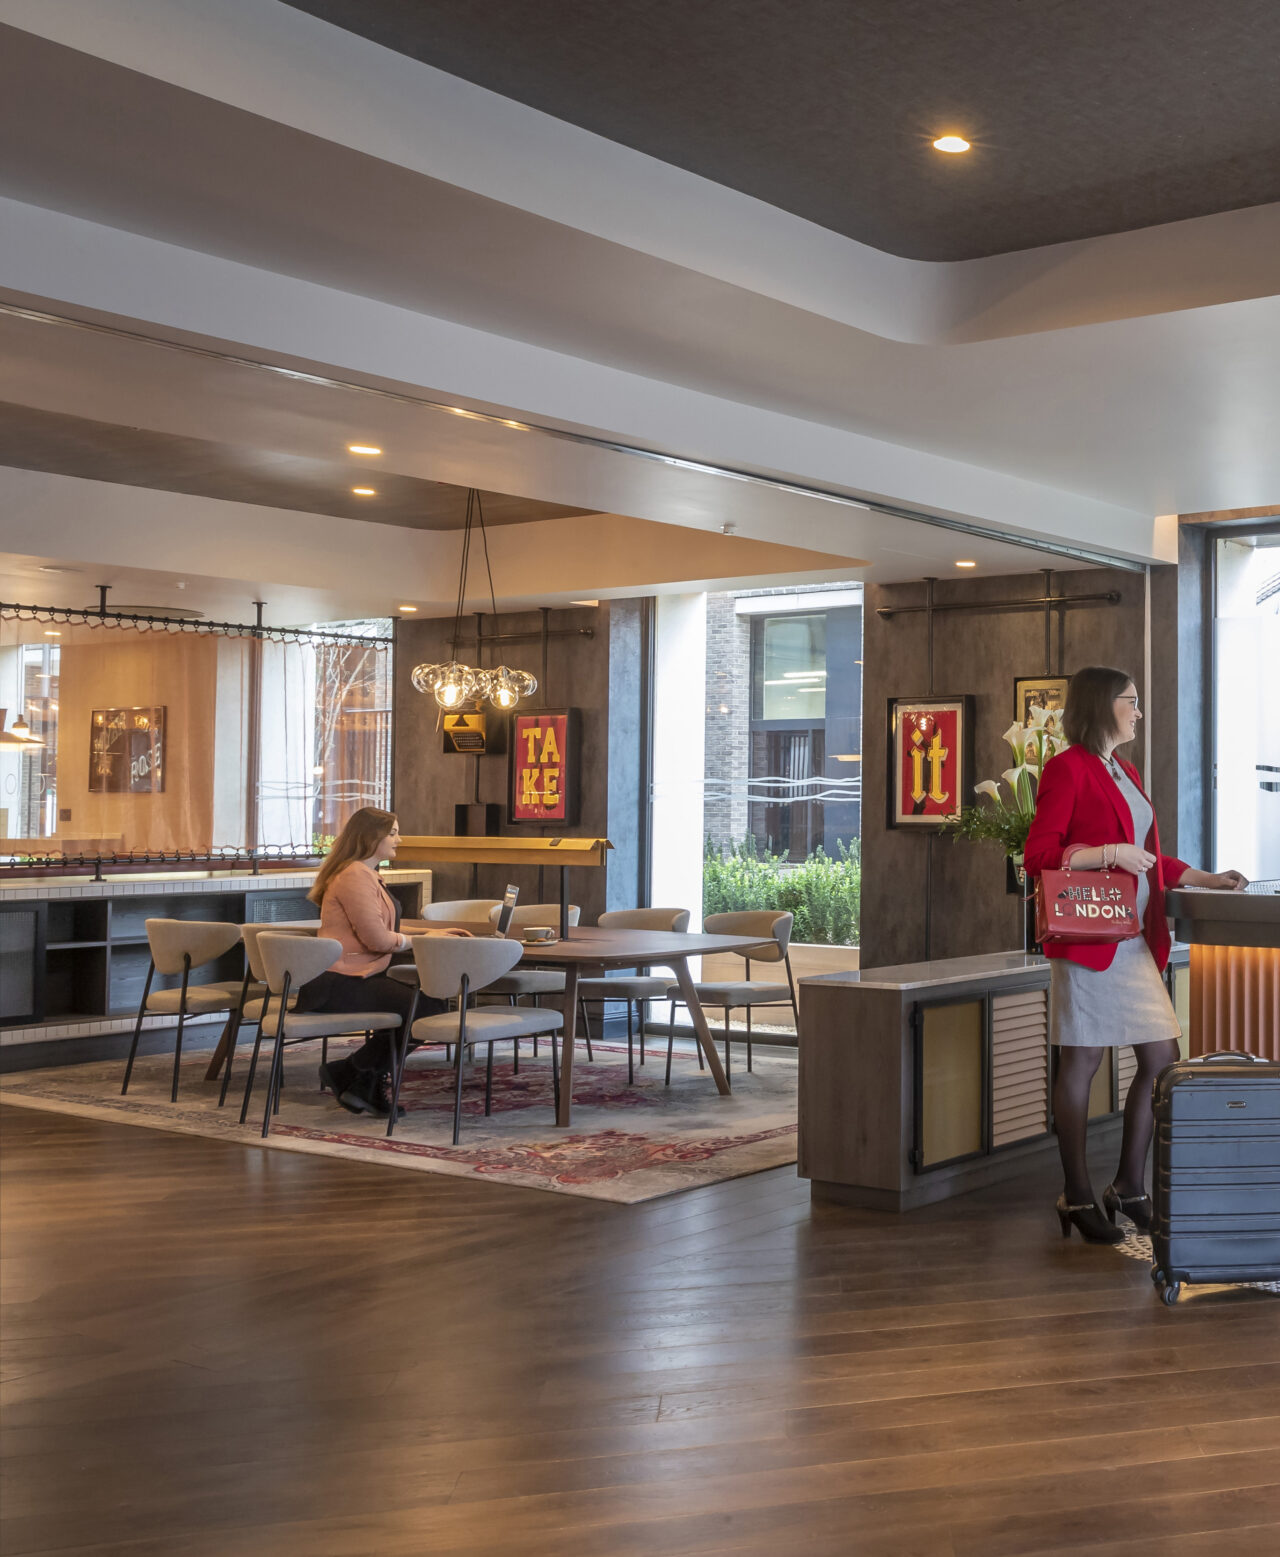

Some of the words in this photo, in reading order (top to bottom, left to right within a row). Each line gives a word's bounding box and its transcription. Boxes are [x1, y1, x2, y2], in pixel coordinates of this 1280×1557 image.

[522, 727, 561, 763] TA
[911, 728, 949, 804] it
[522, 768, 560, 805] KE
[1068, 886, 1122, 901] HELLO
